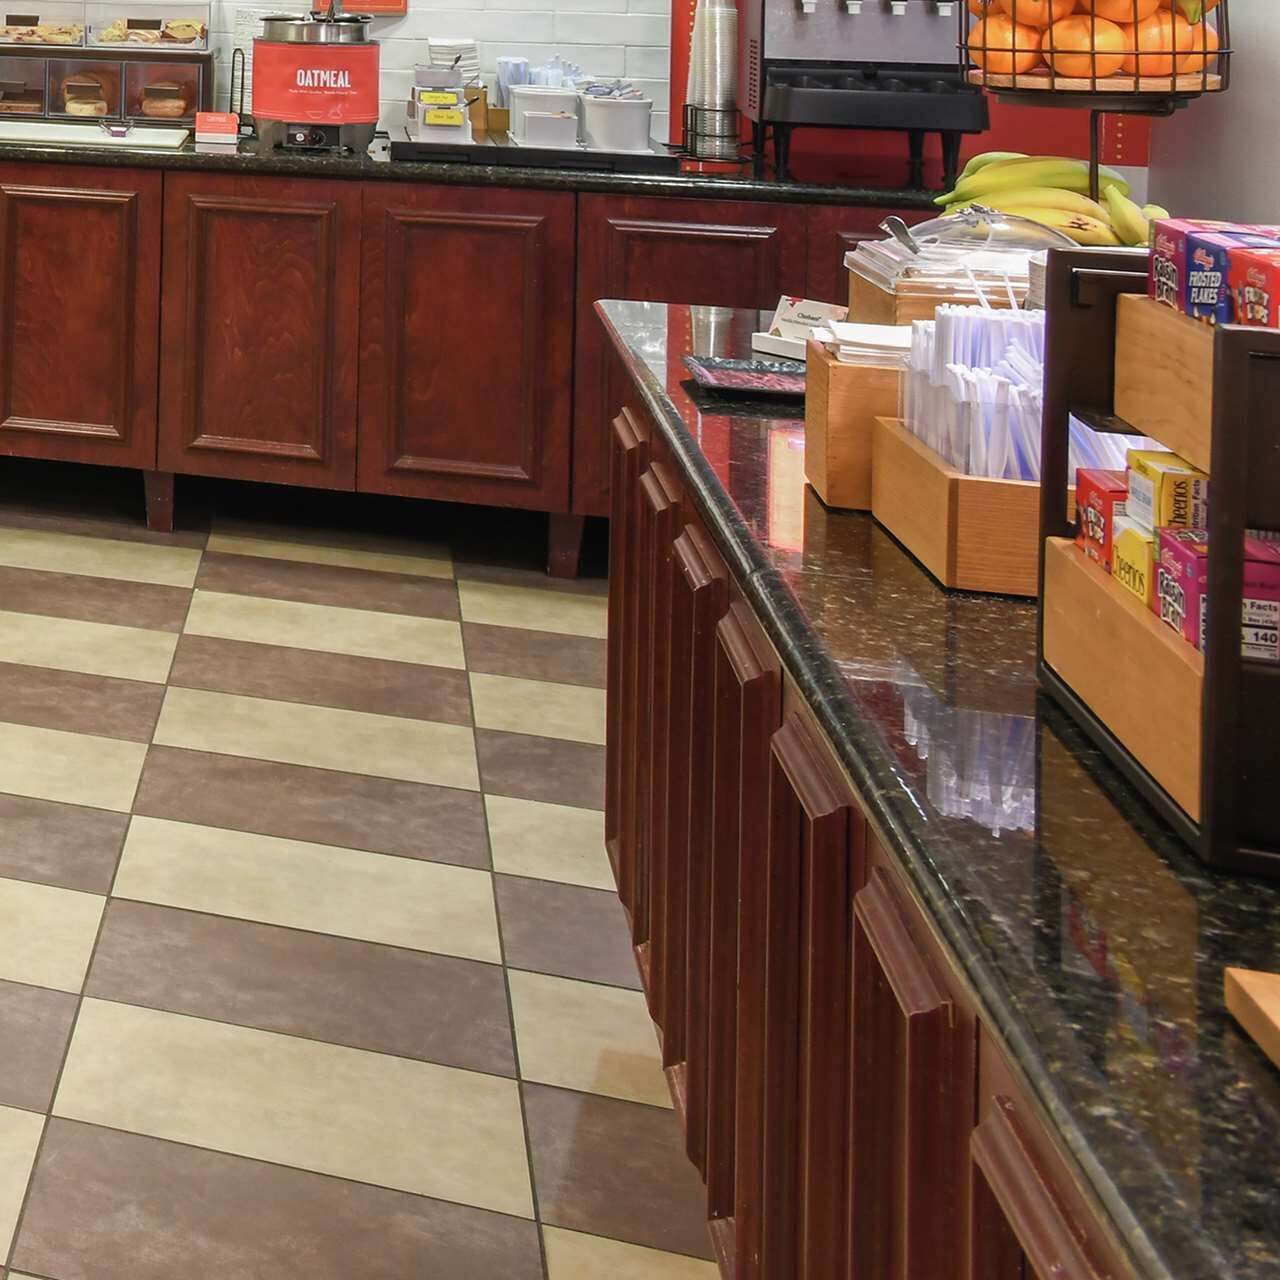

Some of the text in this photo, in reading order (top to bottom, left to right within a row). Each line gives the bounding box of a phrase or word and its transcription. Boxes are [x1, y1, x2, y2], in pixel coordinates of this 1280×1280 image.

[296, 69, 351, 88] OATMEAL
[1188, 271, 1222, 288] FROSTED
[1190, 287, 1219, 304] FLAKES
[1167, 480, 1189, 528] heerios
[1250, 601, 1278, 613] Facts
[1253, 631, 1278, 644] 140
